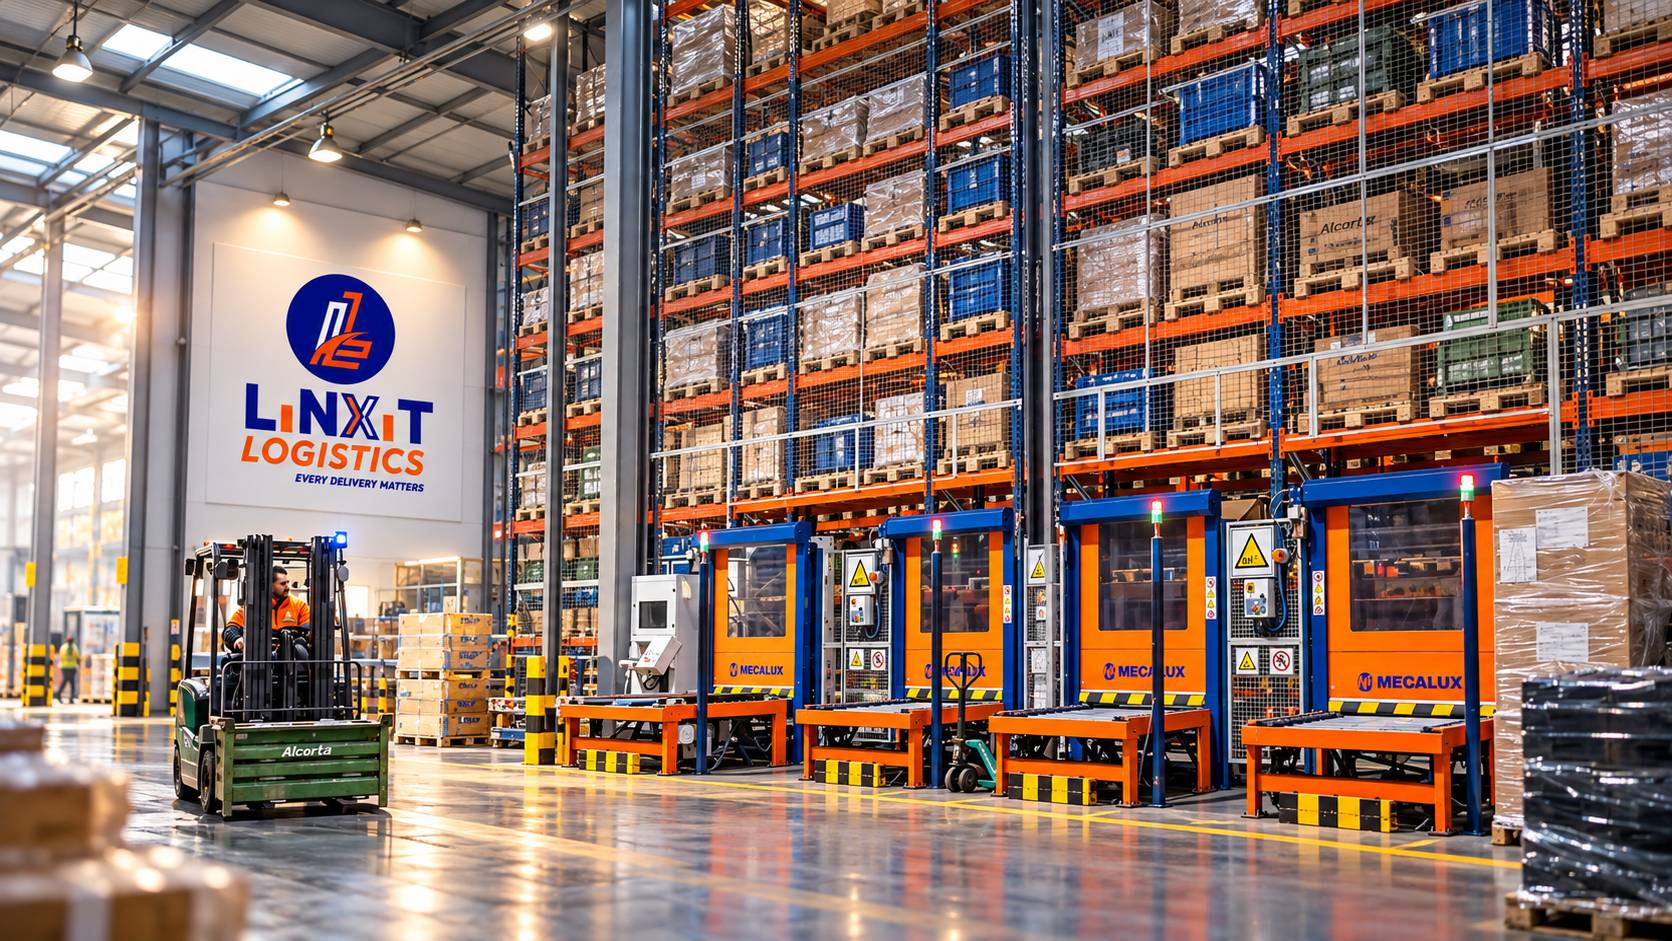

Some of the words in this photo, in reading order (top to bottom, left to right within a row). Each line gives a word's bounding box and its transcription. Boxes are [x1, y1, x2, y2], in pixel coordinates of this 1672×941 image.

[241, 435, 424, 476] LOGISTICS
[295, 473, 328, 486] EVERY
[330, 476, 377, 490] DELIVERY
[379, 480, 424, 492] MATTERS
[740, 664, 784, 676] MECALUX
[1377, 675, 1462, 689] MECALUX
[282, 745, 332, 757] Alcorta
